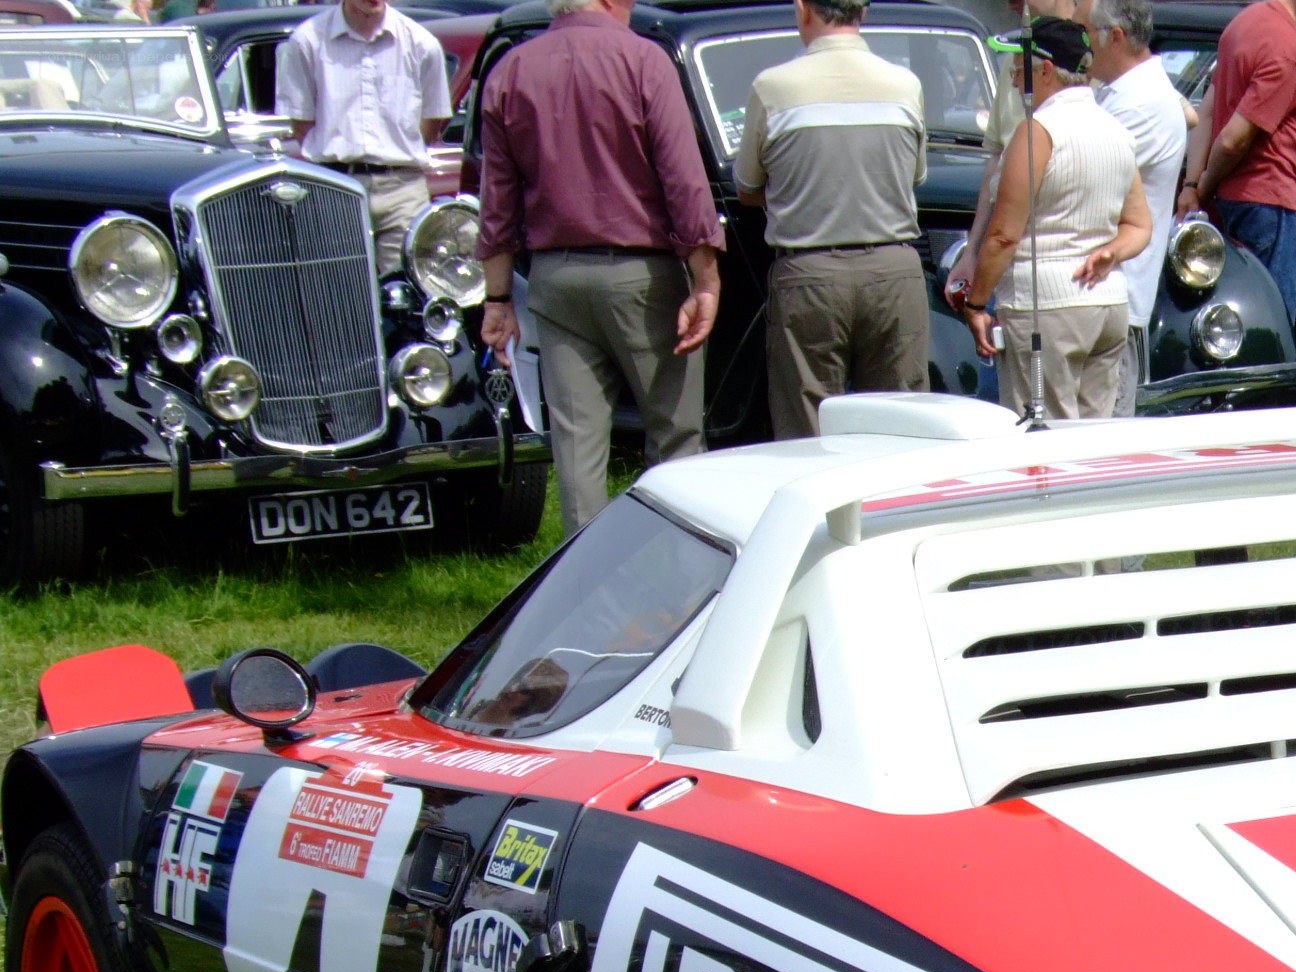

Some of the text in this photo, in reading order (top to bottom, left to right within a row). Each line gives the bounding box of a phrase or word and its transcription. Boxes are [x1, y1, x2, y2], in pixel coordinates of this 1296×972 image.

[259, 490, 424, 537] DON 642
[634, 704, 673, 729] BERTON
[292, 791, 384, 832] RALLYE SANREMO
[154, 812, 222, 926] HF
[321, 838, 361, 871] FIAMM
